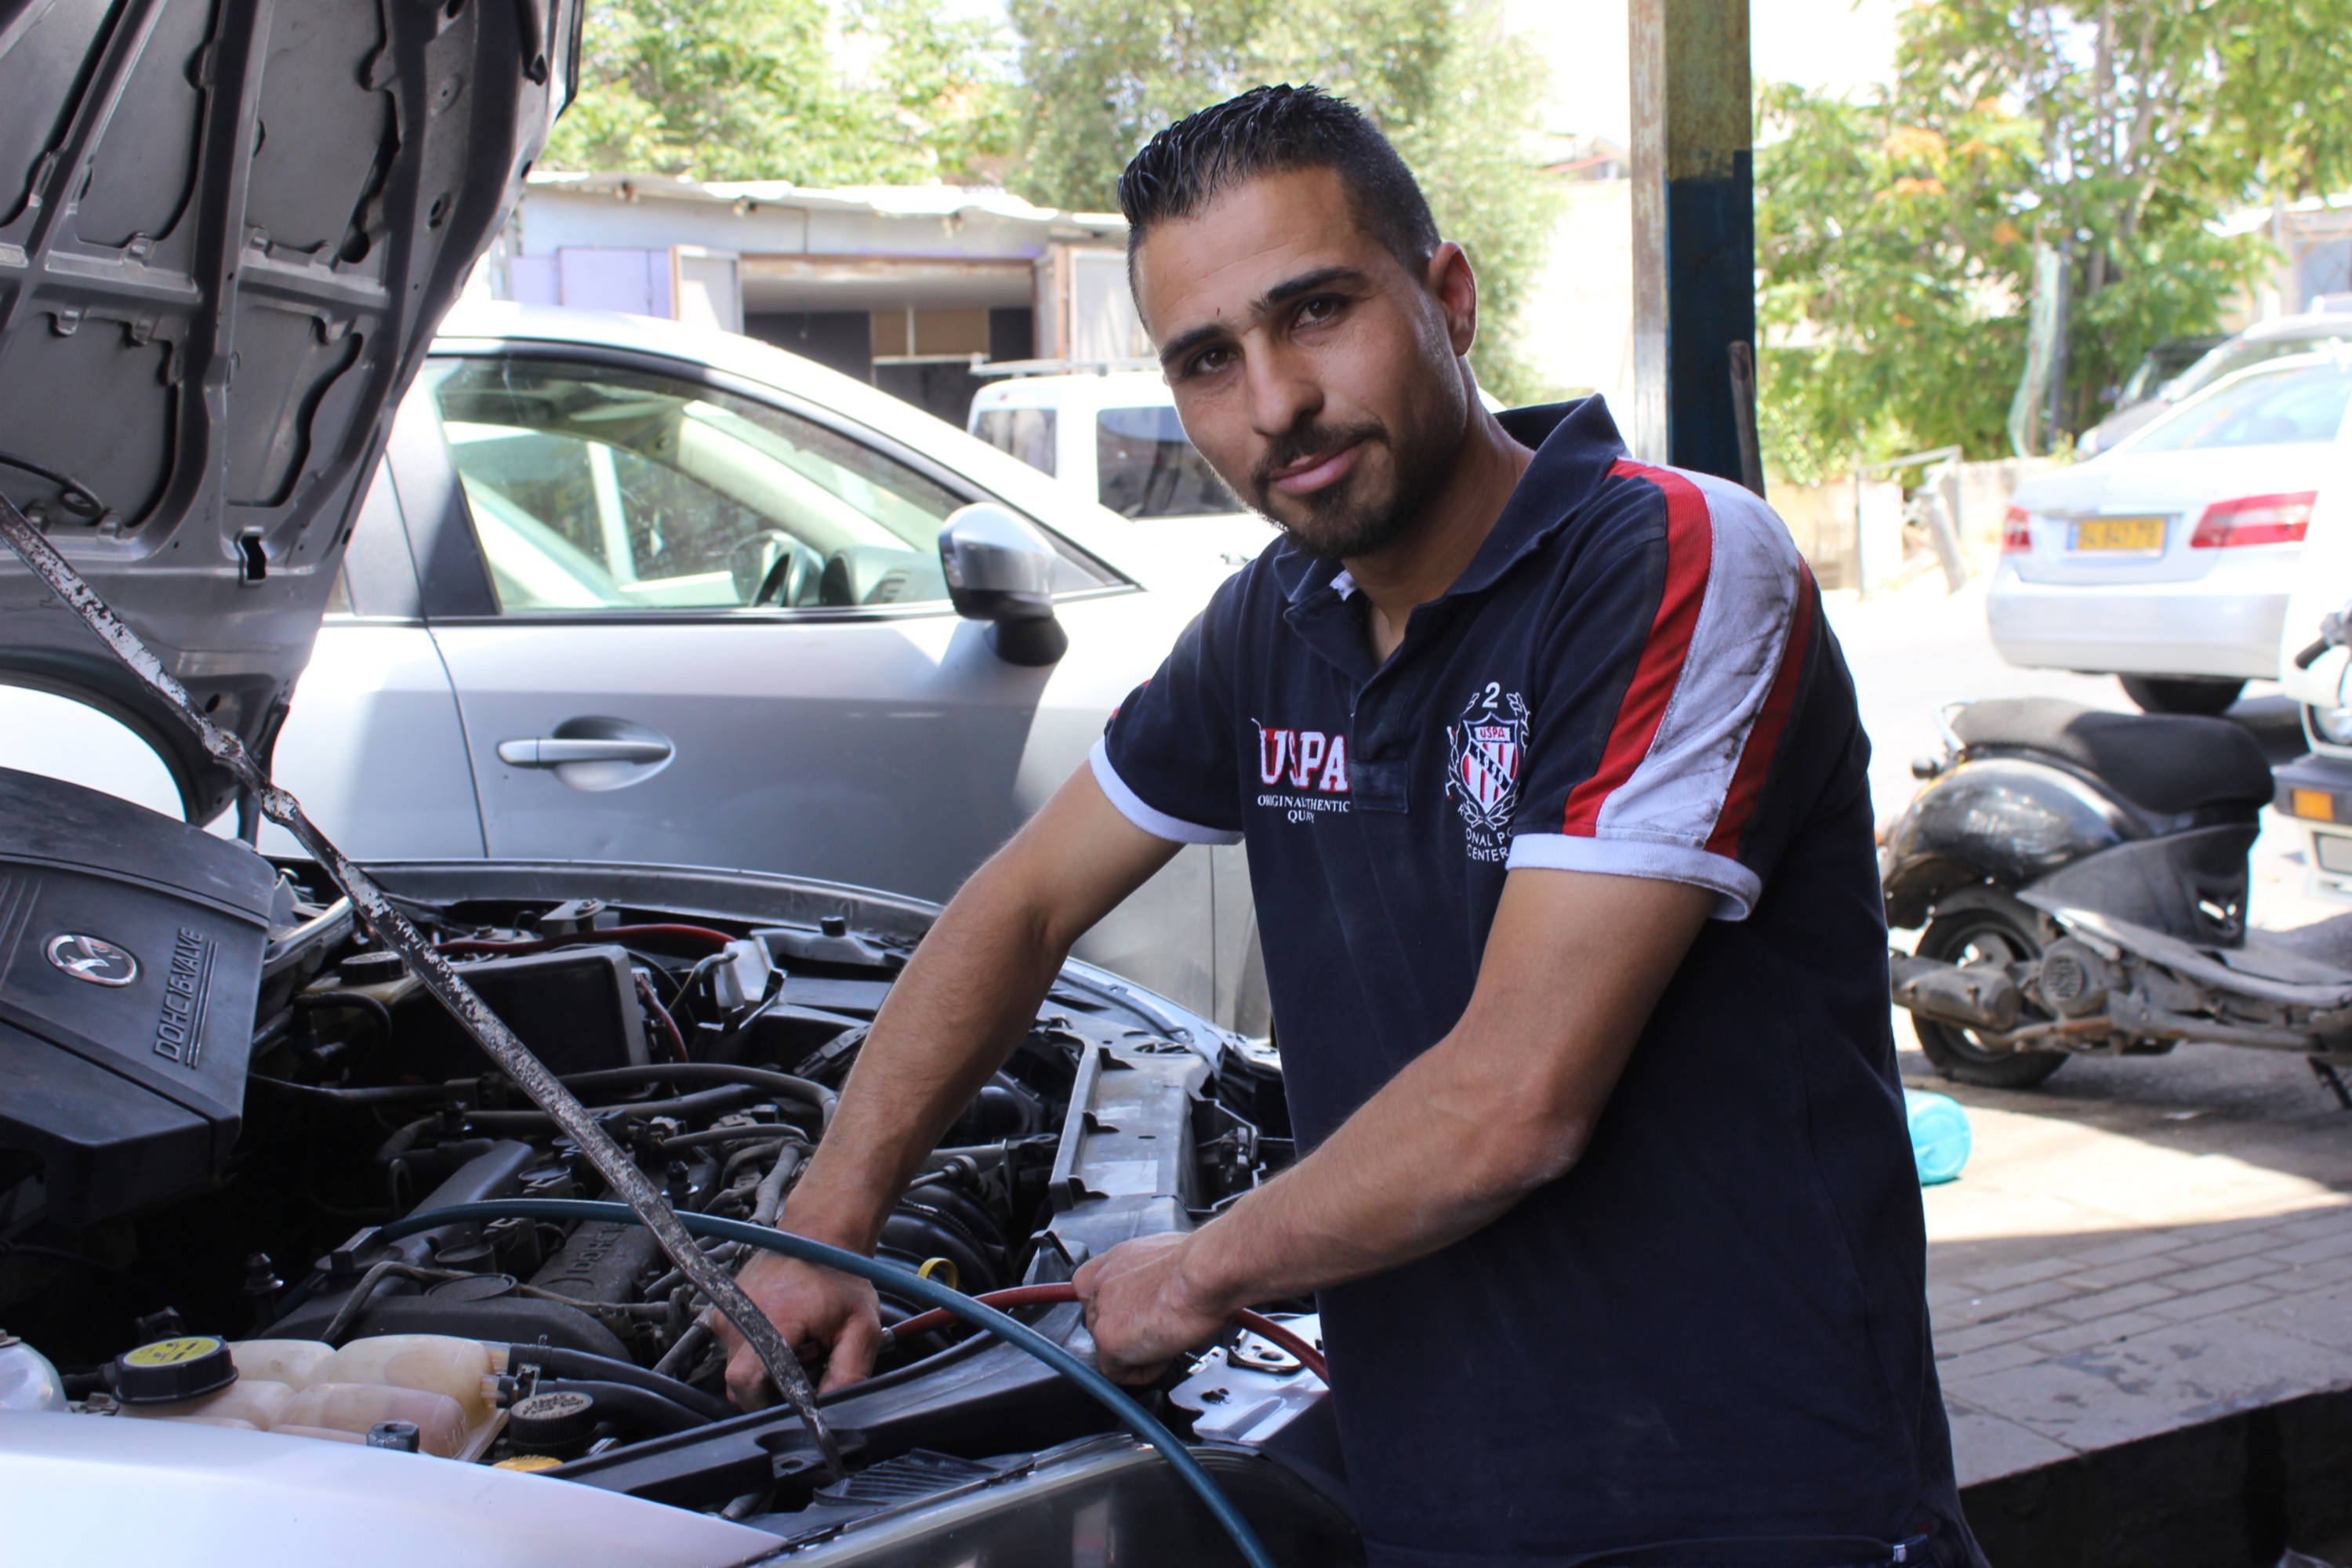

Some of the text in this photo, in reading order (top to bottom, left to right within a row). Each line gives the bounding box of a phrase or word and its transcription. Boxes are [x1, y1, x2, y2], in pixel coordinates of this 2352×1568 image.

[1479, 726, 1506, 739] USPA
[1260, 728, 1351, 793] USPA
[1475, 746, 1504, 786] 1890
[1466, 844, 1509, 862] CENTER
[154, 993, 191, 1062] DOHC
